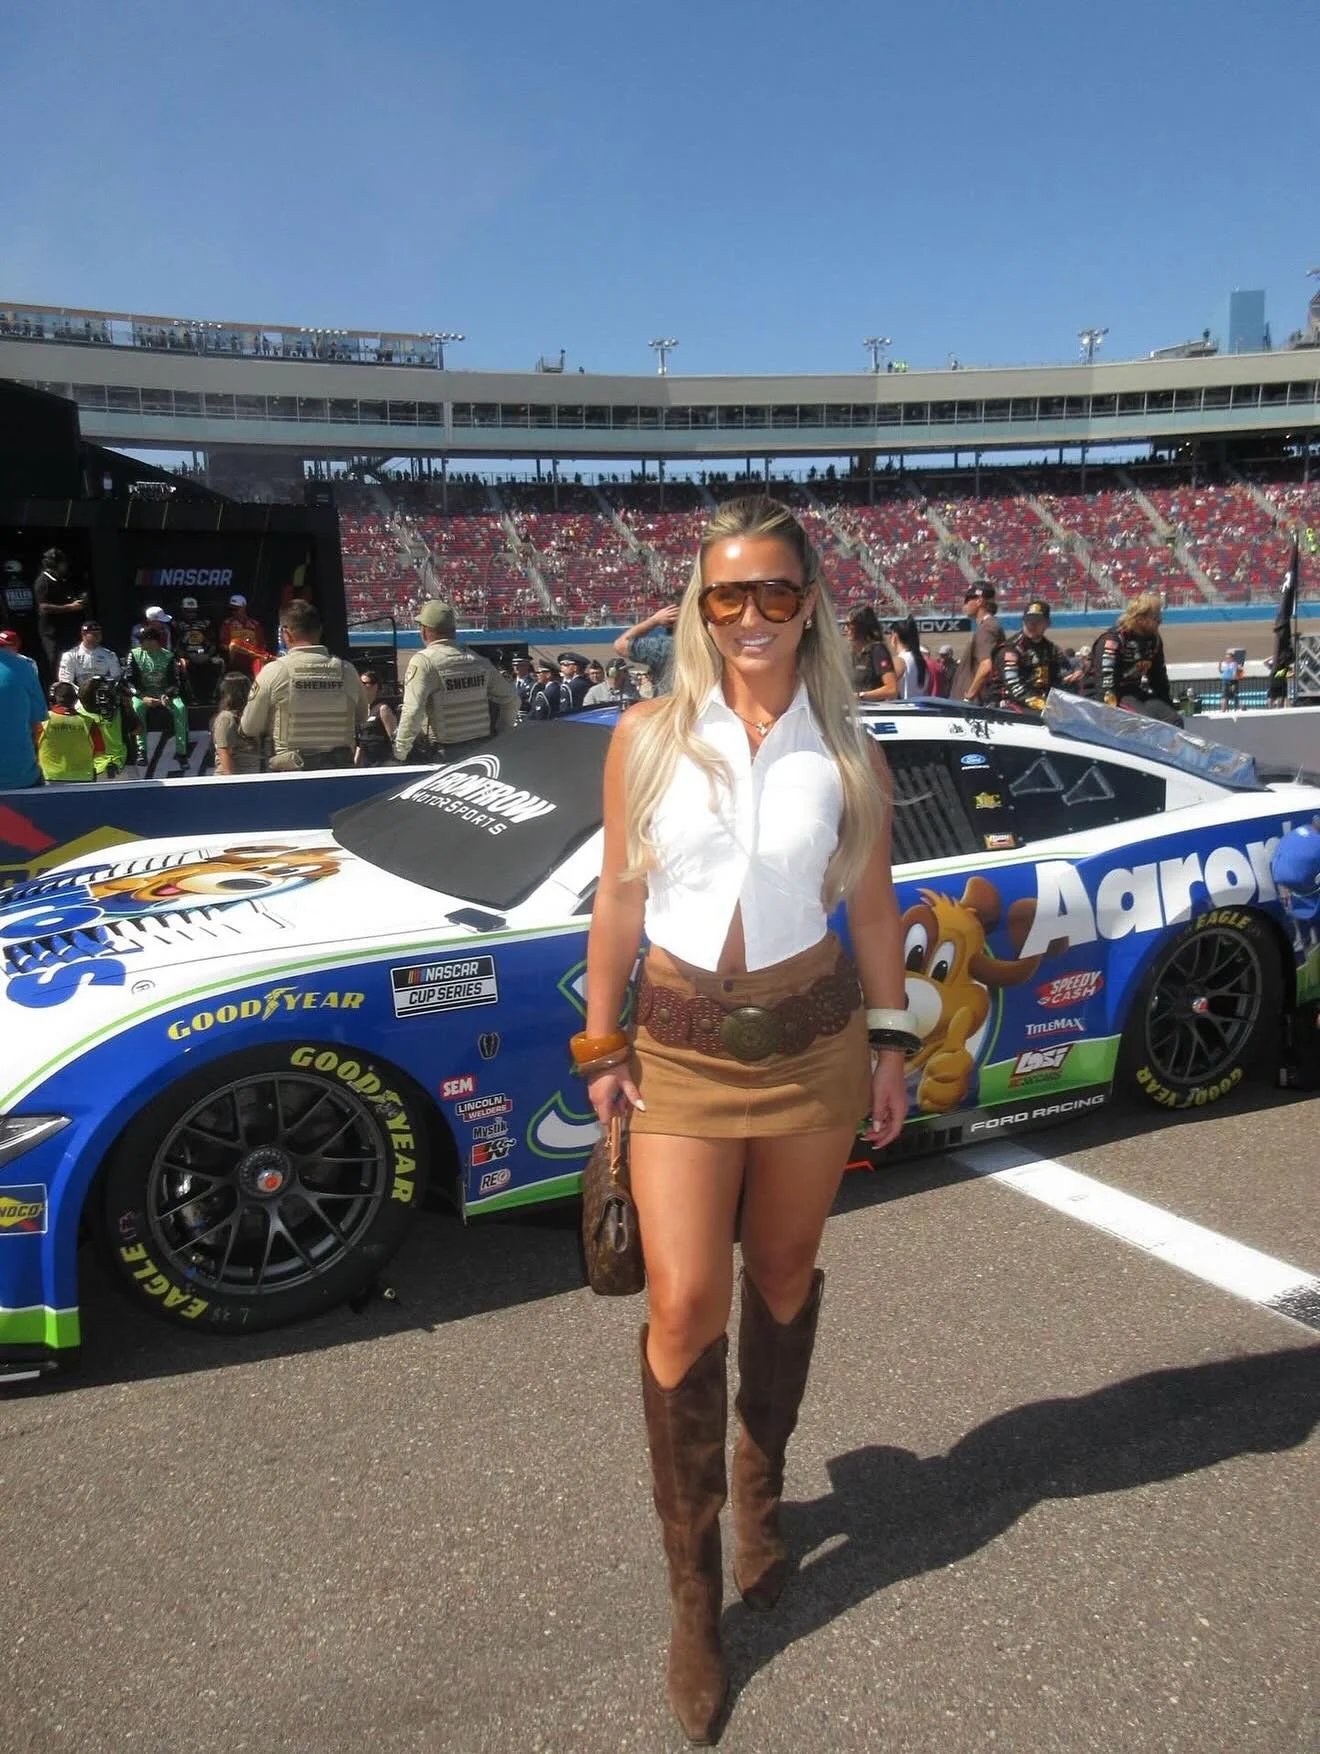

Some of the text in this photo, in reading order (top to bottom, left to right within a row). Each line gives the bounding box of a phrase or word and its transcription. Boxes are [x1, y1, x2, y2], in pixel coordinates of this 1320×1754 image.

[160, 569, 233, 586] NASCAR
[295, 681, 345, 690] SHERIFF
[446, 675, 485, 691] SHERIFF
[412, 791, 507, 835] MOTORSPORTS
[1018, 821, 1292, 959] Aaron'
[1196, 910, 1252, 929] EAGLE
[426, 962, 479, 981] NASCAR
[1050, 971, 1102, 994] SPEEDY
[409, 982, 482, 1004] CUP SERIES
[1051, 986, 1096, 1004] CASH
[443, 1077, 473, 1096] SEM
[458, 1097, 502, 1113] LINCOLN
[468, 1105, 507, 1119] WELDERS
[971, 1095, 1105, 1132] FORD RACING
[120, 1242, 208, 1319] EAGLE
